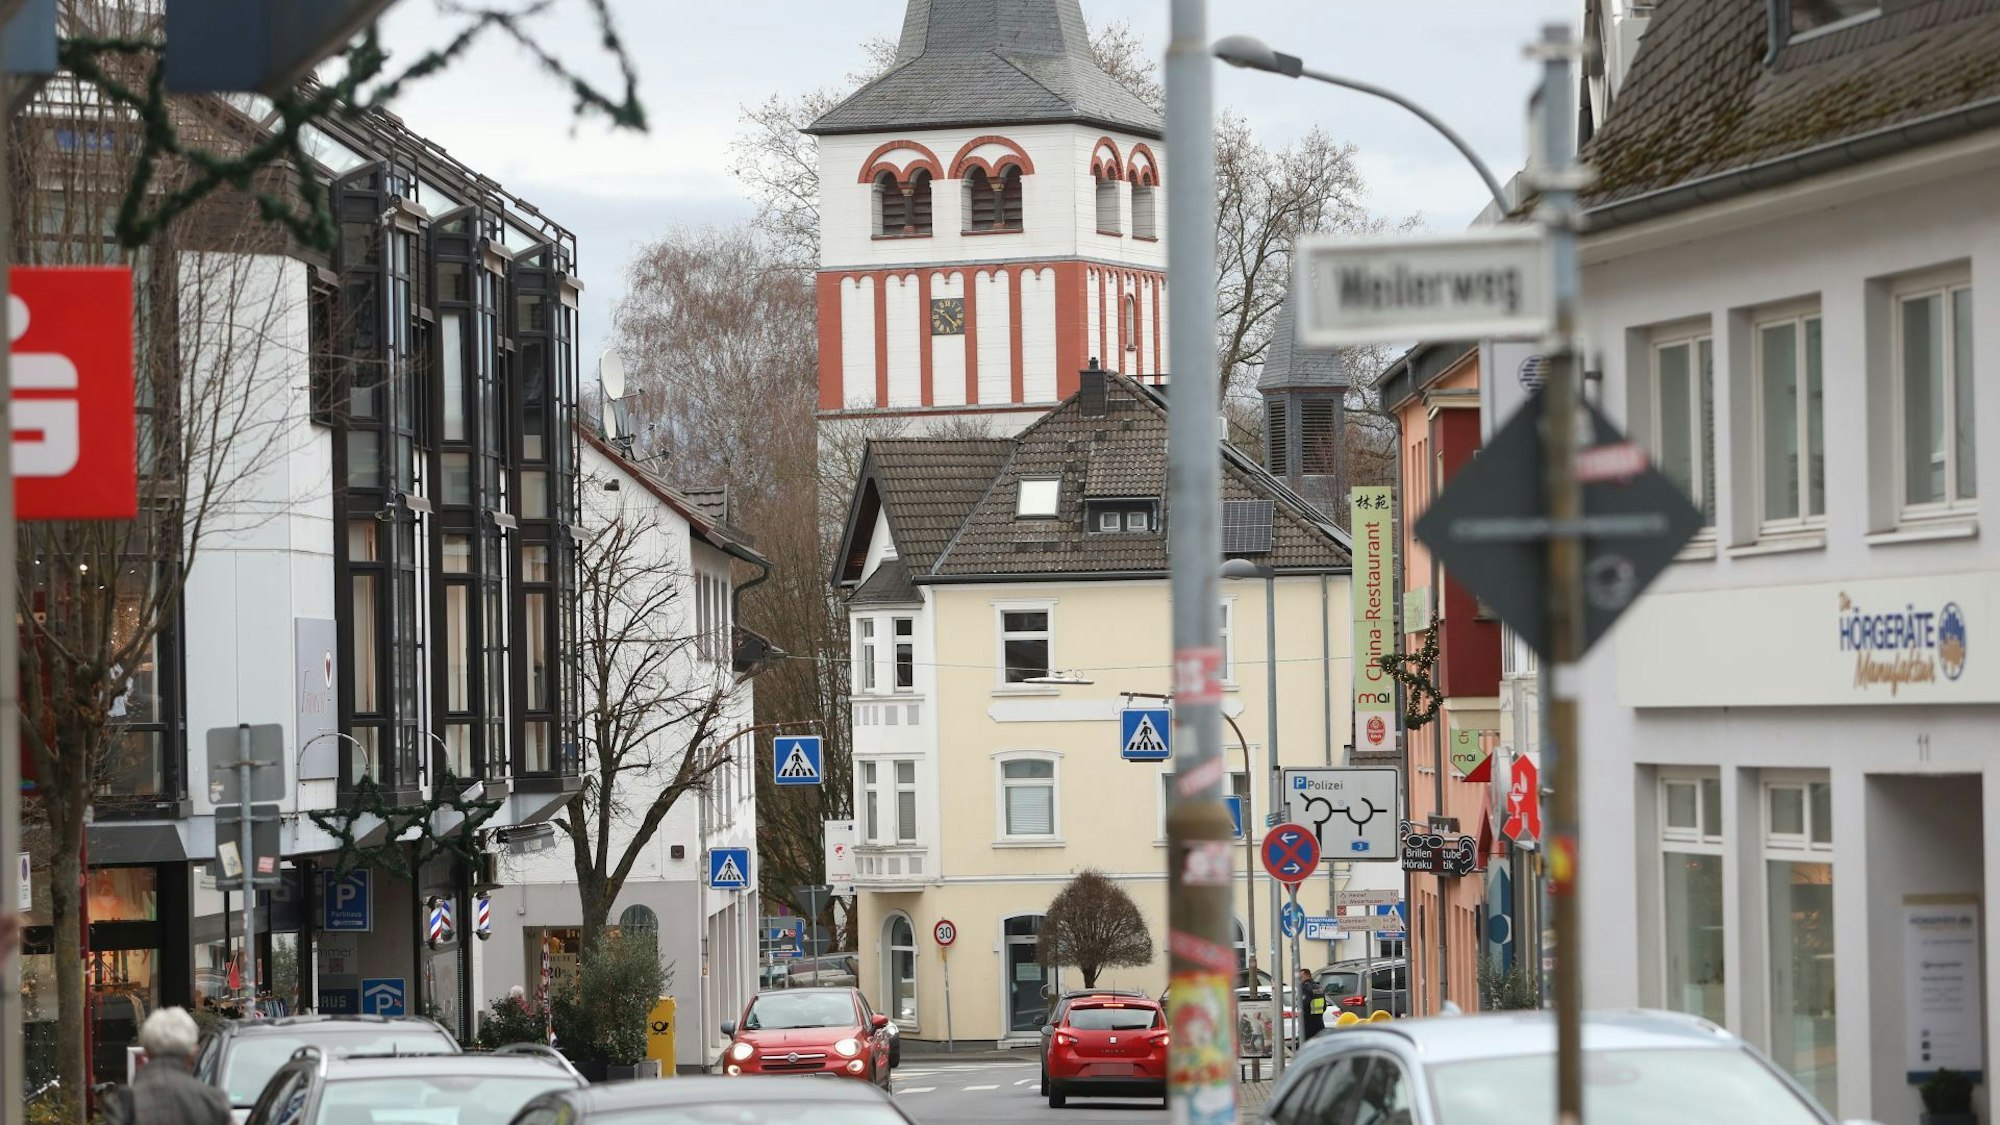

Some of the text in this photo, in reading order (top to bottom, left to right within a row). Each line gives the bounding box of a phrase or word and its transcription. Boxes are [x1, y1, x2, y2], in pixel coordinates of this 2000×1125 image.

[1365, 521, 1382, 681] China-Restaurant
[1840, 604, 1934, 651] HÖRGERÄTE
[1854, 650, 1936, 697] Manufaktur
[1358, 692, 1390, 704] mai
[1917, 733, 1930, 761] 11
[1453, 753, 1476, 762] mai
[1307, 780, 1343, 790] Polizei
[1406, 848, 1461, 859] Brillen tube
[1402, 859, 1454, 870] Höraku tik
[938, 927, 952, 940] 30
